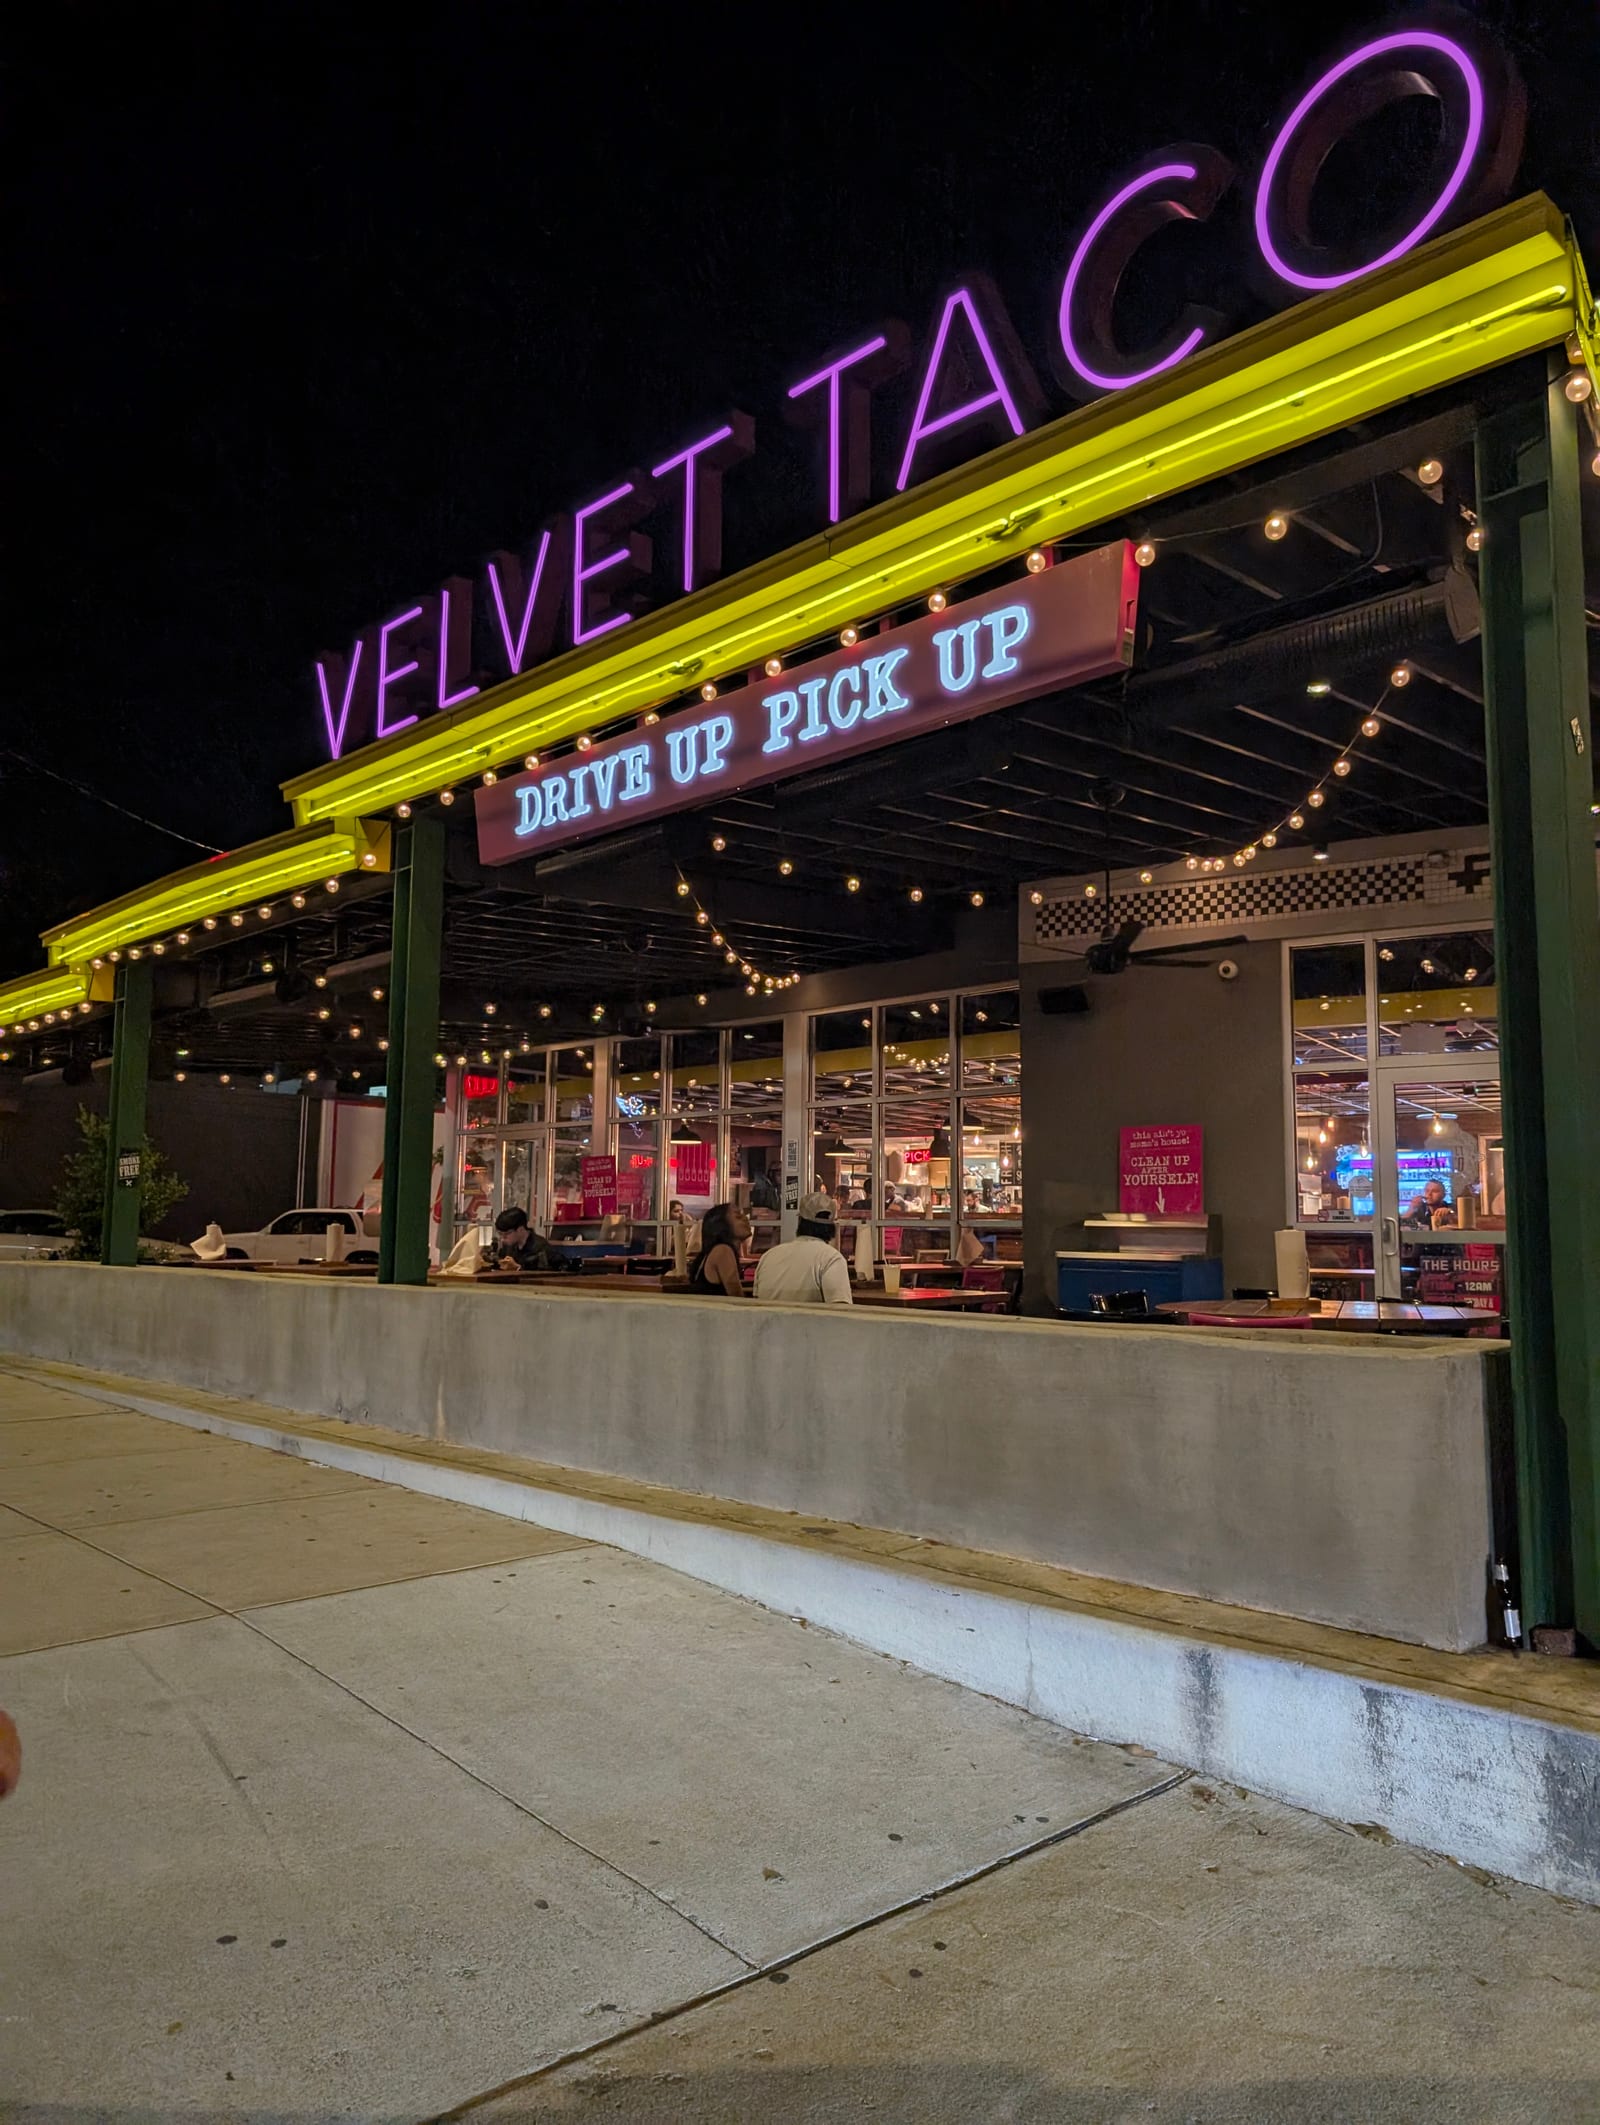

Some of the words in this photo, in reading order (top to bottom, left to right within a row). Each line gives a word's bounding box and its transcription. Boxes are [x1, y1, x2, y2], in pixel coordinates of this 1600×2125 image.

[316, 425, 733, 760] VELVET
[788, 31, 1483, 523] TACO
[514, 742, 651, 838] DRIVE
[665, 715, 733, 784] UP
[761, 646, 909, 754] PICK
[932, 604, 1030, 692] UP
[1132, 1131, 1151, 1140] this
[1161, 1136, 1190, 1146] house!
[904, 1150, 931, 1163] PICK
[1130, 1156, 1170, 1168] CLEAN
[1174, 1155, 1190, 1167] UP
[119, 1165, 140, 1177] FREE
[1141, 1166, 1168, 1174] AFTER
[1123, 1173, 1199, 1186] YOURSELF!
[1423, 1260, 1449, 1271] THE
[1453, 1260, 1500, 1271] HOURS
[1465, 1282, 1492, 1292] 12AM
